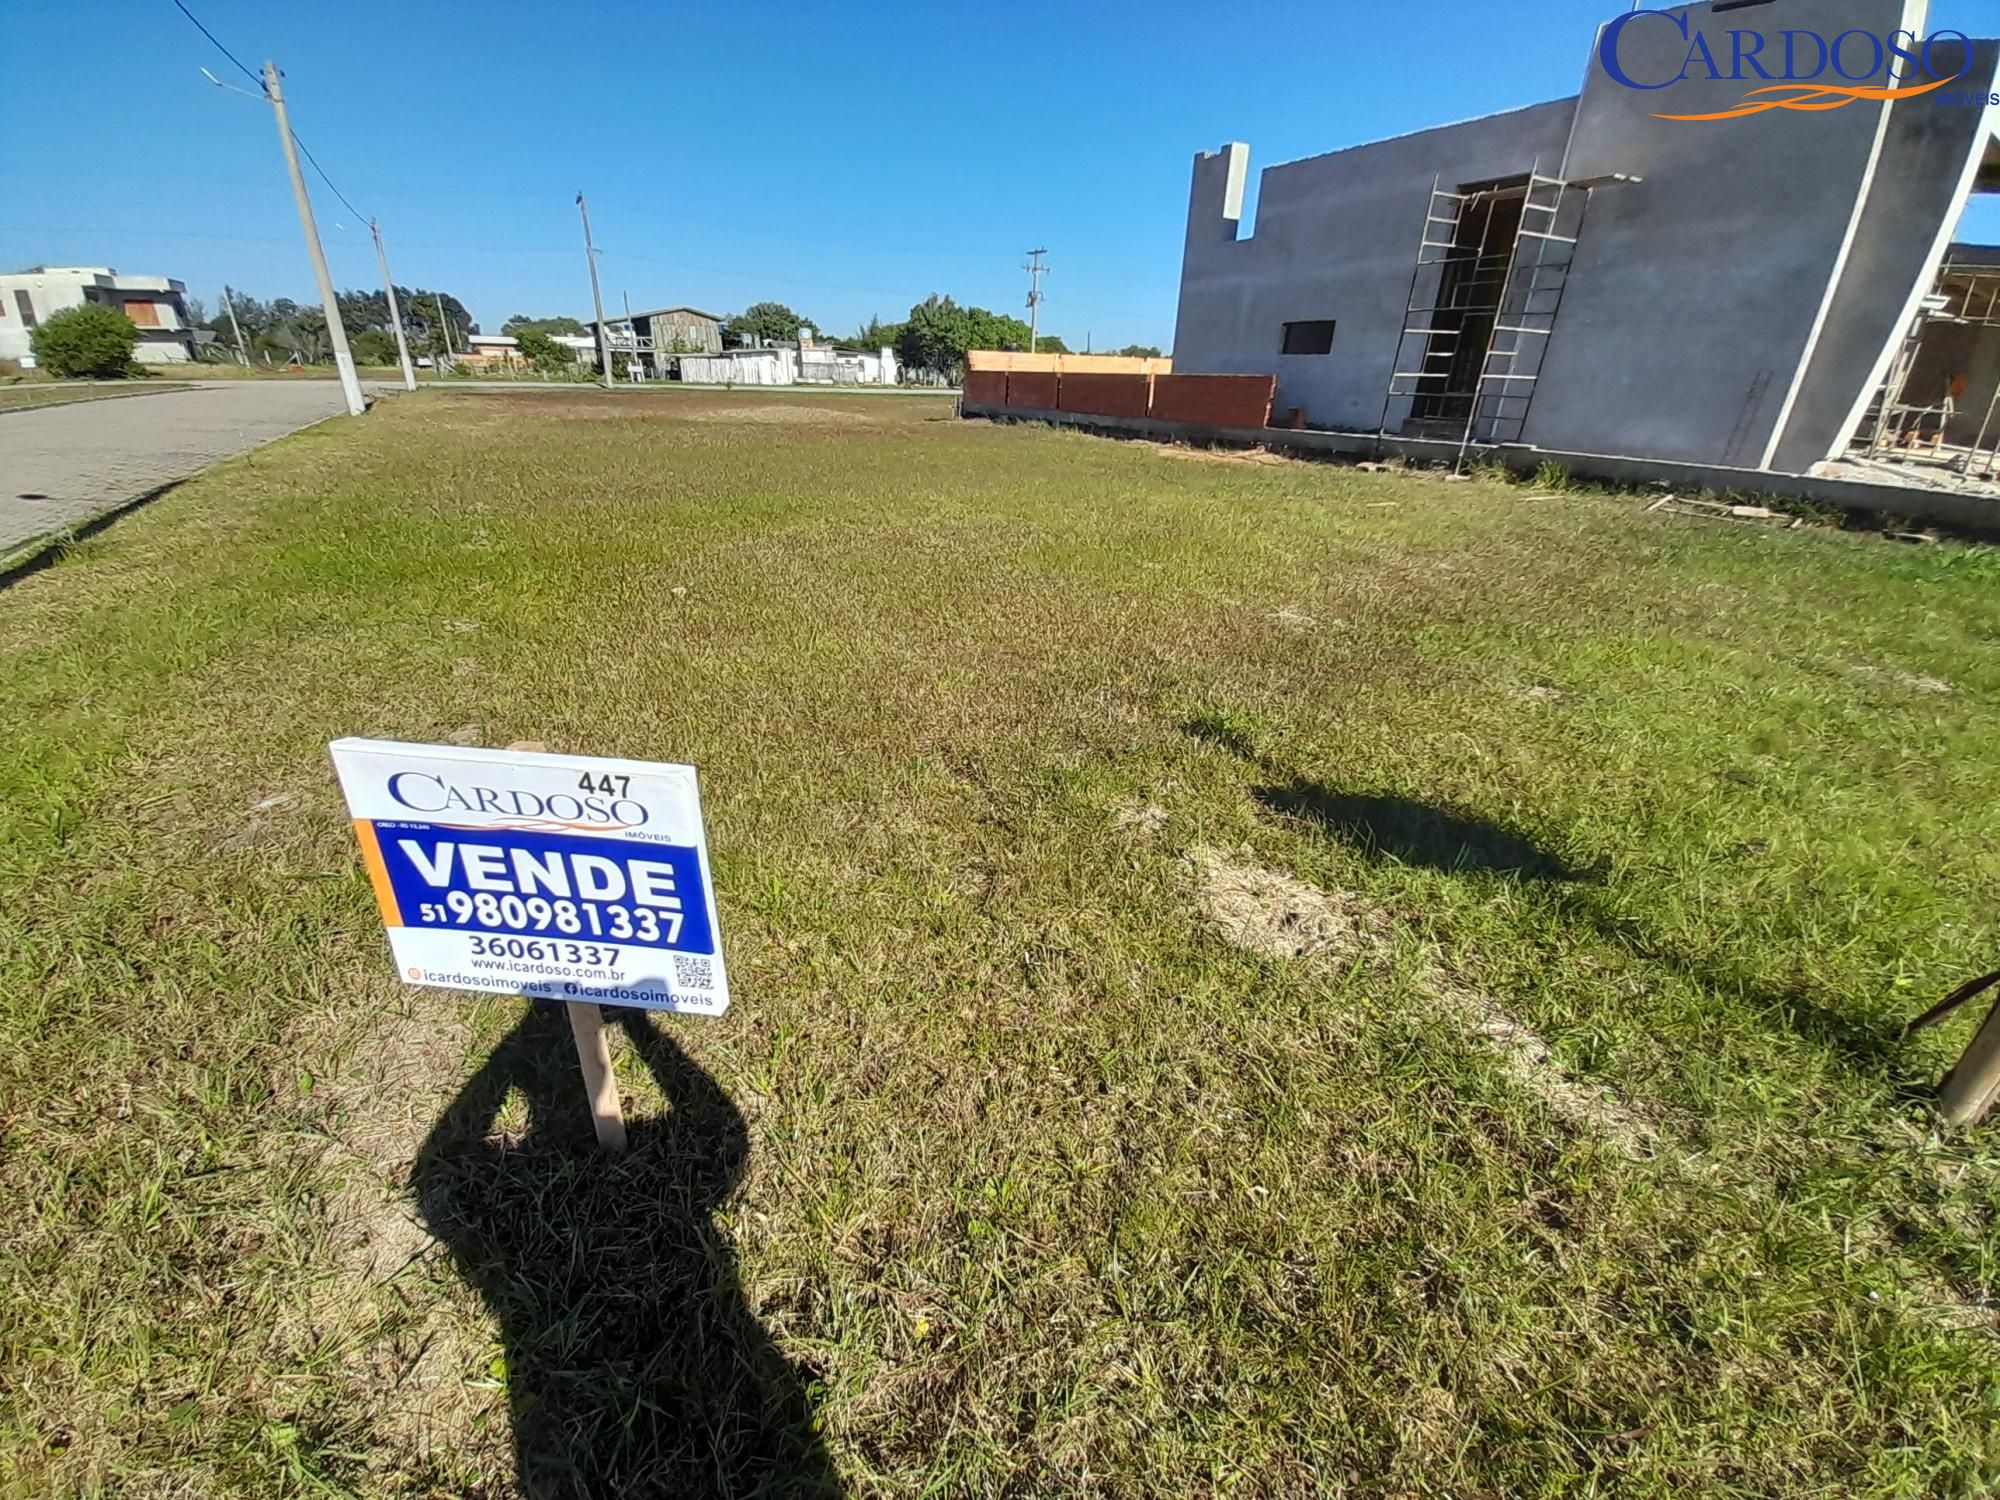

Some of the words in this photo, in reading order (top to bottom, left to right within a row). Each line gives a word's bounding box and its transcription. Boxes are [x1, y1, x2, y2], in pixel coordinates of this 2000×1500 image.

[578, 771, 630, 798] 447
[387, 772, 649, 827] CARDOSO
[624, 831, 672, 843] IMÓVEIS
[397, 839, 683, 910] VENDE
[420, 903, 447, 923] 51
[447, 890, 684, 944] 980981337
[468, 935, 620, 967] 36061337
[424, 970, 552, 993] icardosoimoveis
[471, 958, 626, 982] www.icardoso.com.br
[579, 983, 713, 1007] icardosoimoveis
